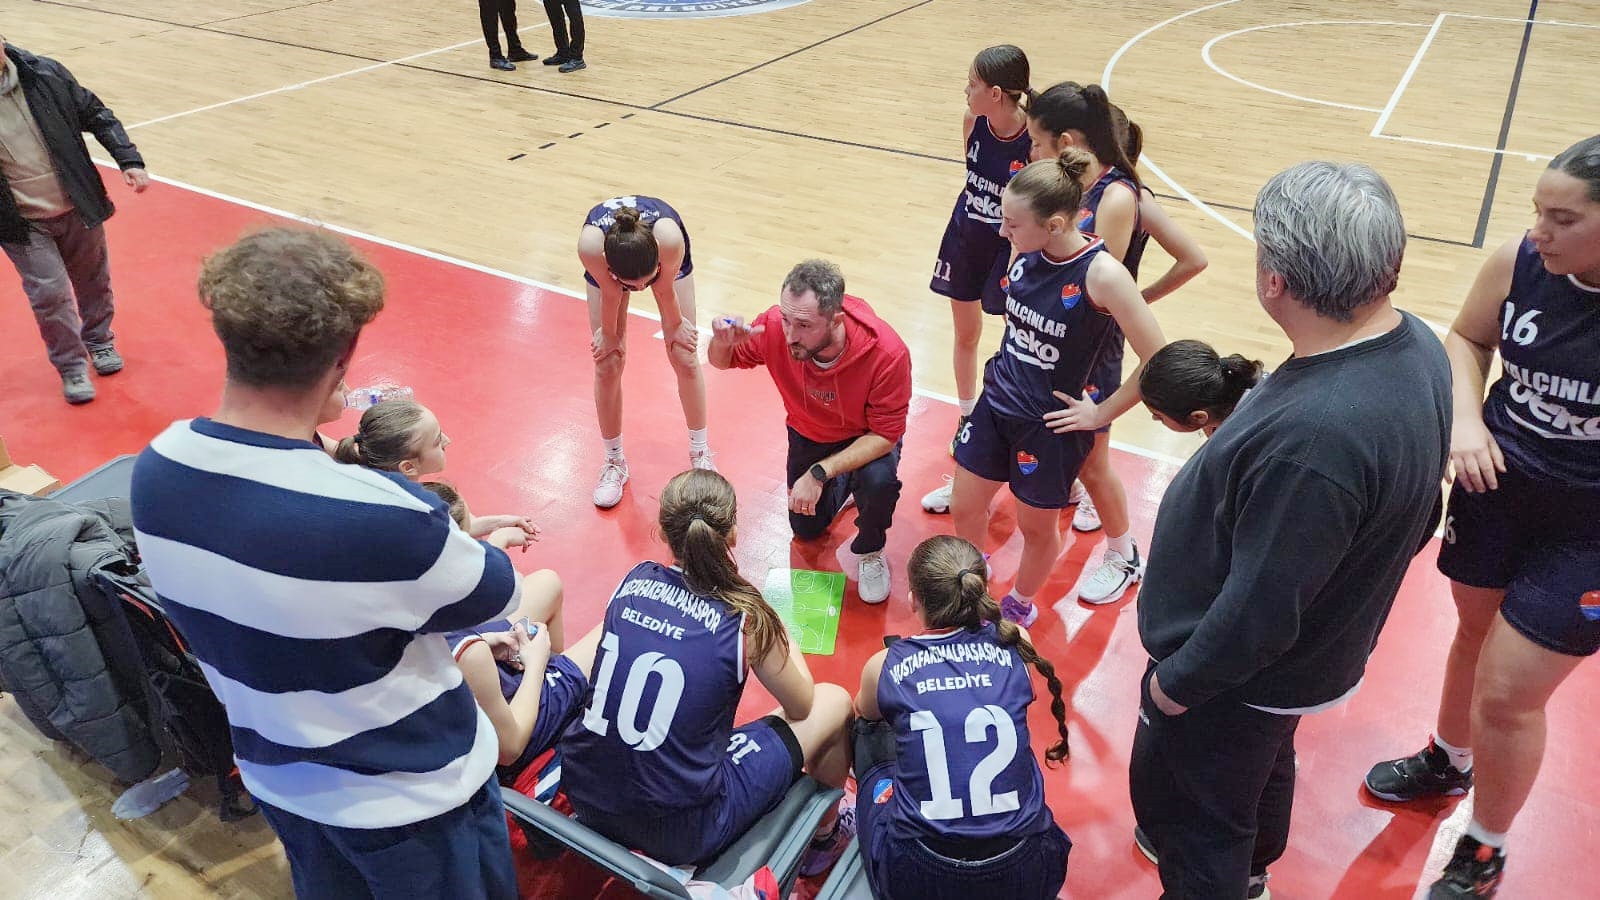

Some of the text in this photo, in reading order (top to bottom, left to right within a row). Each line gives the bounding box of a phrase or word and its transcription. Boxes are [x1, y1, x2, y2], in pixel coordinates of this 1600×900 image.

[934, 258, 951, 282] 11
[1009, 257, 1027, 282] 6
[1502, 301, 1543, 346] 16
[961, 421, 973, 444] 6
[621, 607, 685, 640] BELEDİYE
[582, 631, 685, 751] 10
[916, 672, 992, 695] BELEDİYE
[910, 705, 1020, 820] 12
